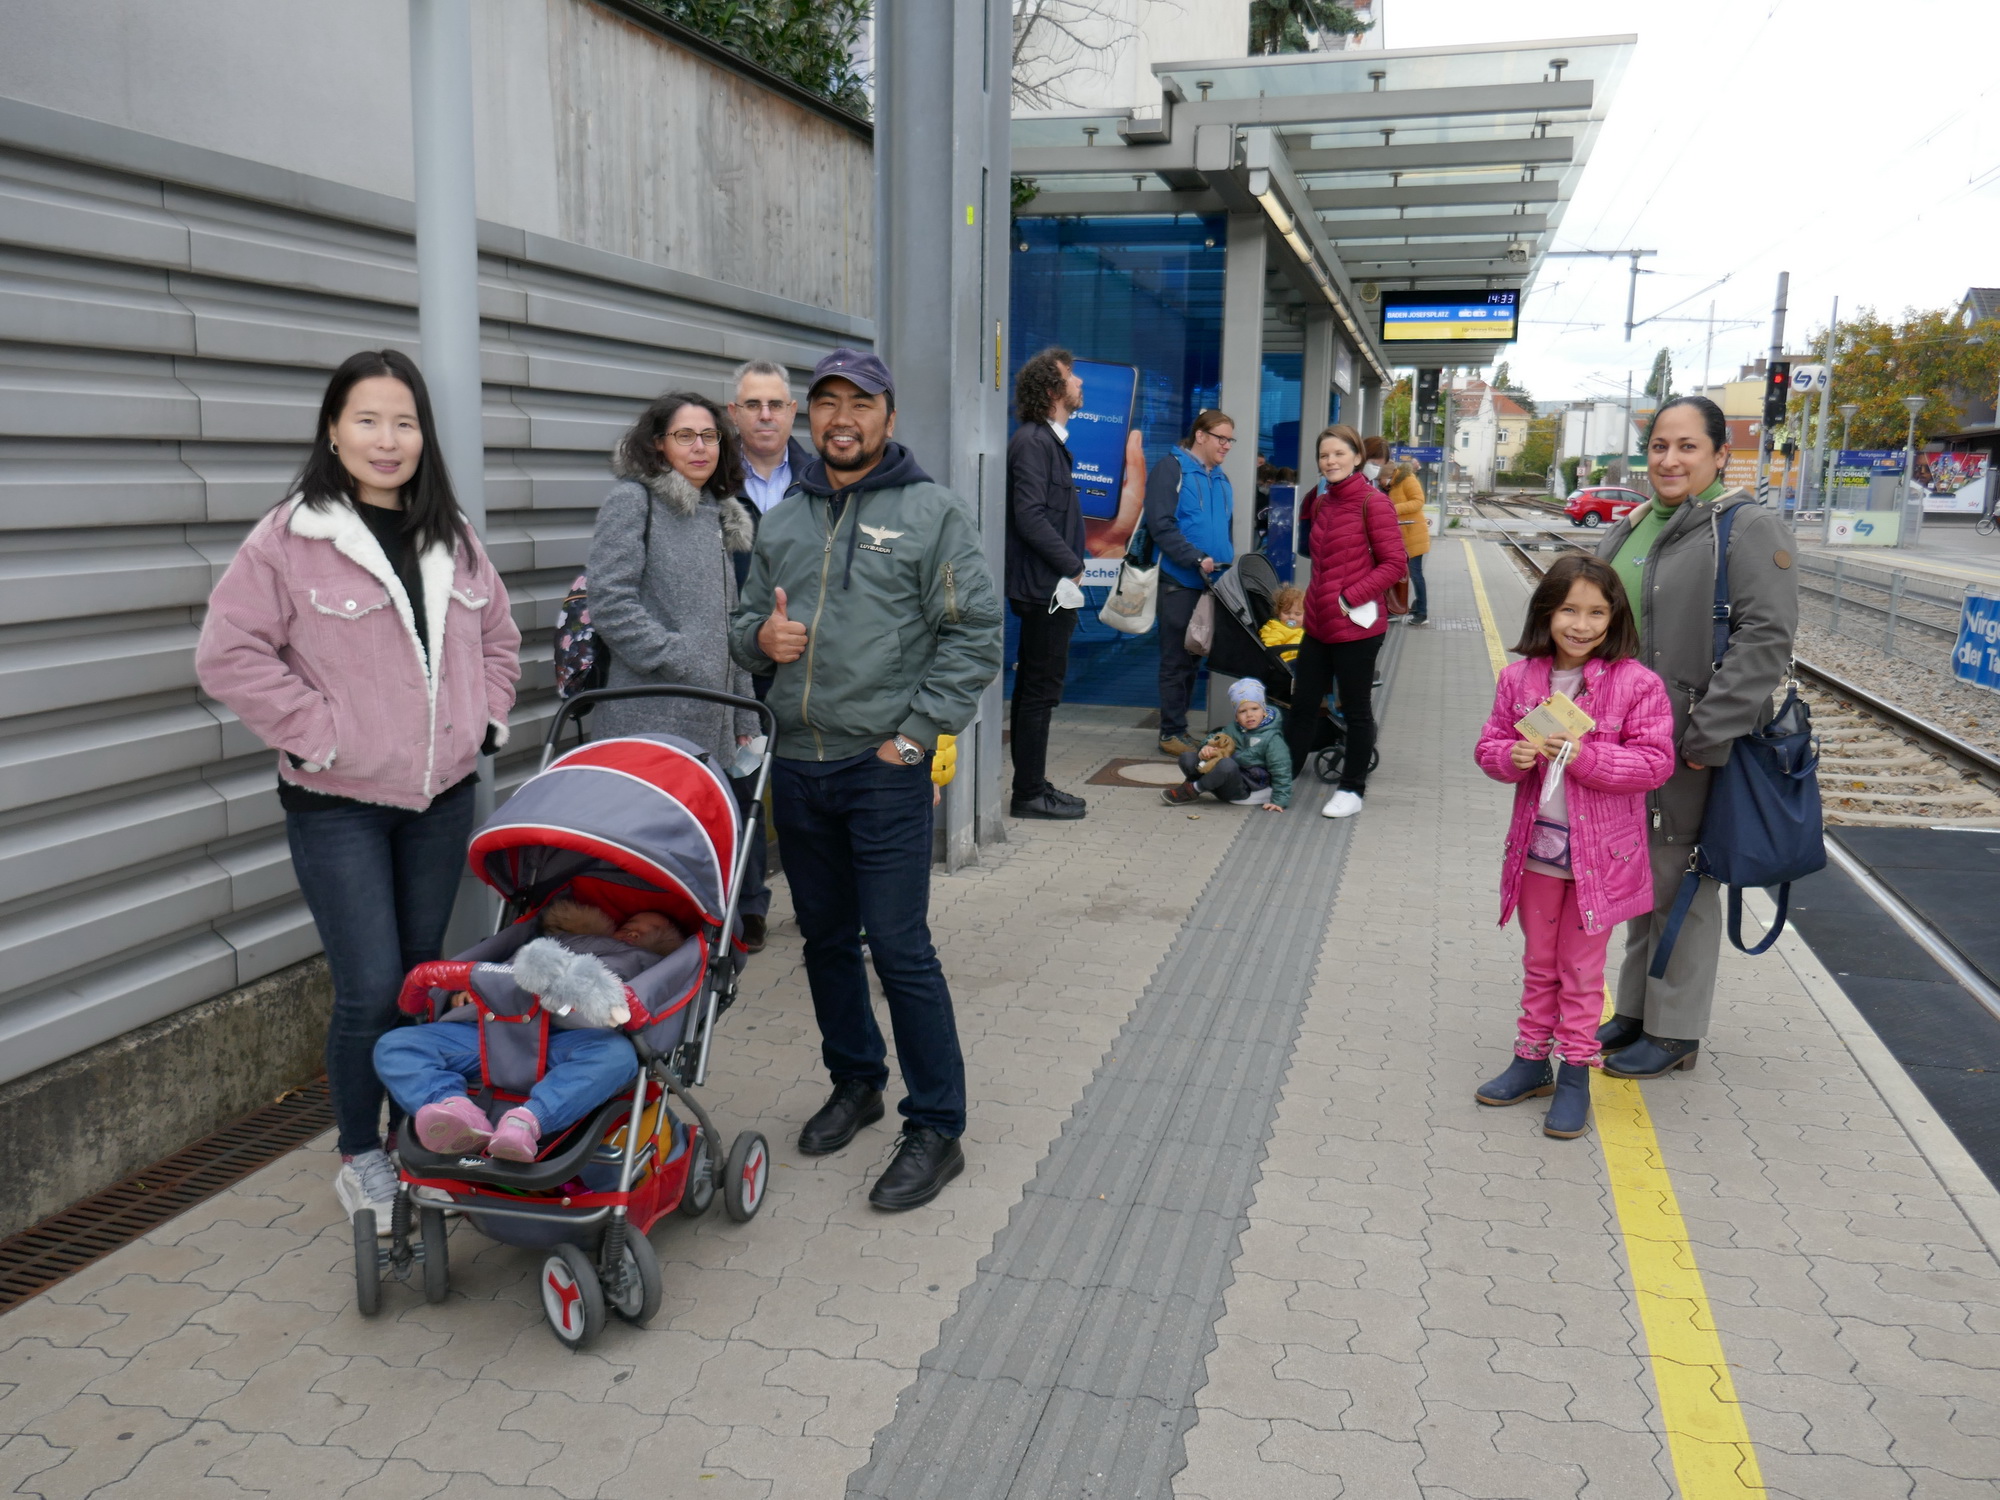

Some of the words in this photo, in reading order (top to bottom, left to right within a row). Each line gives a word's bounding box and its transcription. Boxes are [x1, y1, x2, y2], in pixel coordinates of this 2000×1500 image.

[1487, 294, 1514, 304] 14:33
[1387, 311, 1408, 319] BADEN
[1077, 411, 1123, 424] easymobil
[1076, 462, 1099, 472] Jetzt
[1071, 472, 1113, 484] wnloaden
[1958, 642, 1982, 668] der
